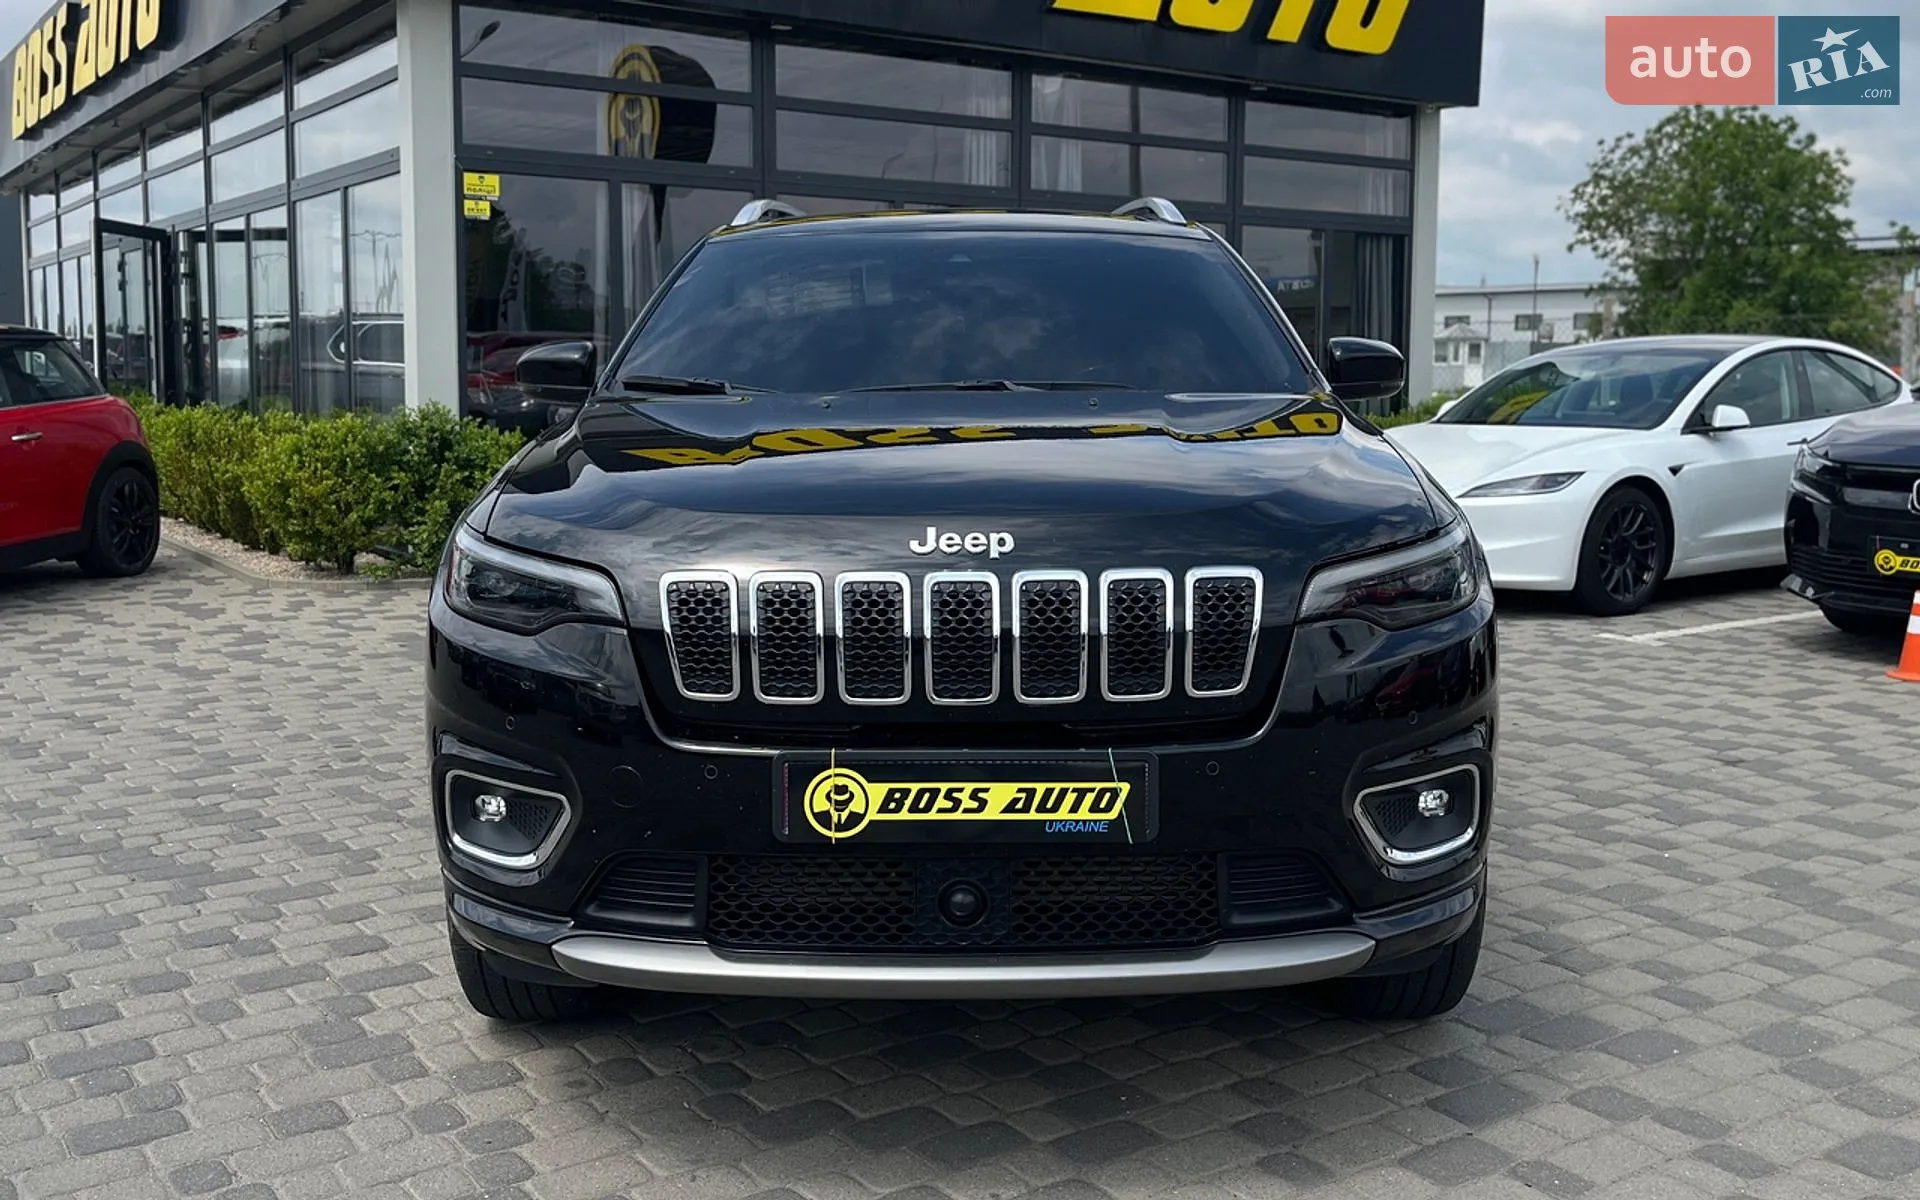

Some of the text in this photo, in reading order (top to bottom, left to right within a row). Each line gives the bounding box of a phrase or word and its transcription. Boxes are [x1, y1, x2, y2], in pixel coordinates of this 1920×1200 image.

[12, 1, 67, 140] BOSS
[908, 526, 1016, 560] Jeep
[1900, 559, 1920, 569] BO
[876, 787, 1118, 814] BOSS AUTO
[1045, 821, 1109, 833] UKRAINE
